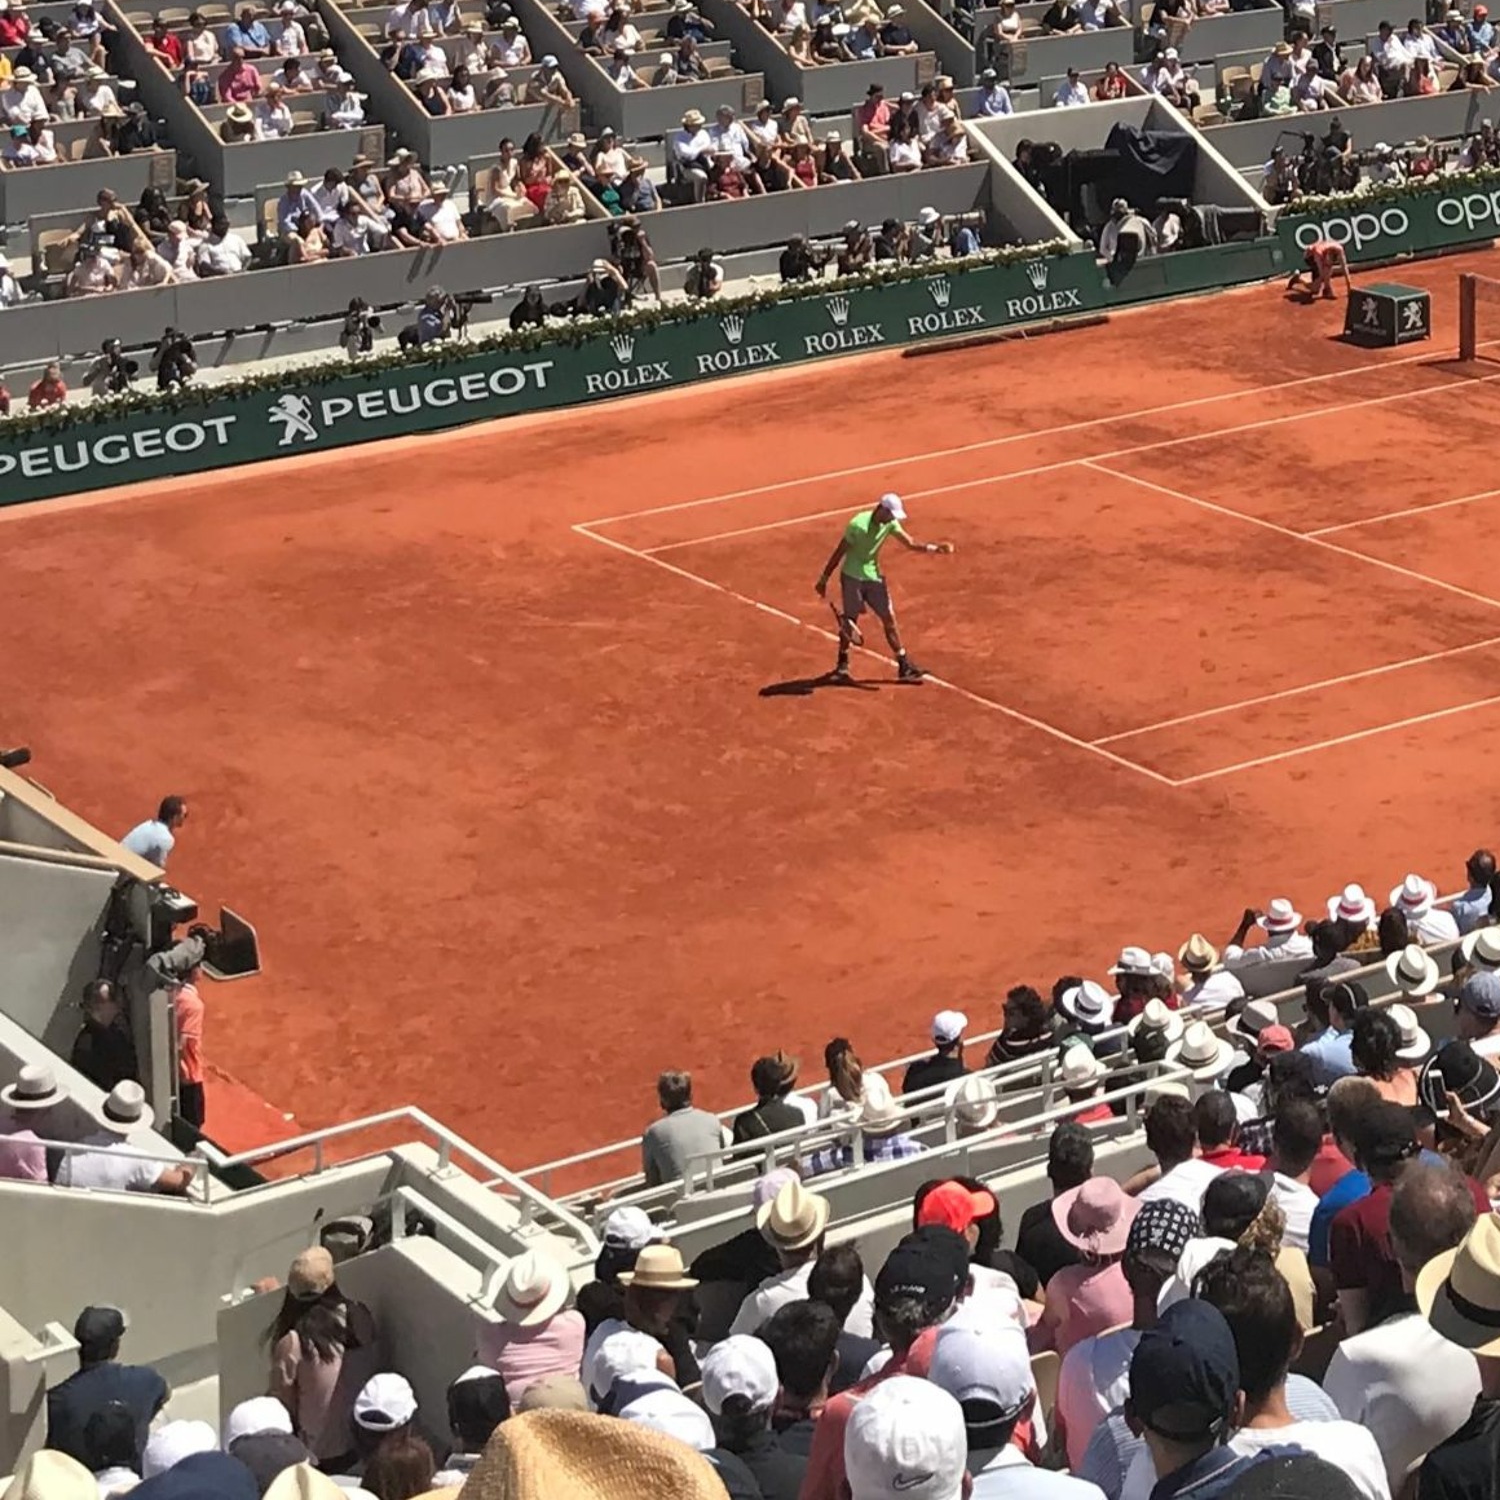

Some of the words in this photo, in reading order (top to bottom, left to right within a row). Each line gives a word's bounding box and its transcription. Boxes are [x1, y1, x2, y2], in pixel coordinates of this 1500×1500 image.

[587, 362, 673, 393] ROLEX
[697, 342, 781, 374] ROLEX
[805, 324, 885, 354] ROLEX
[909, 306, 986, 335] ROLEX
[1007, 289, 1082, 317] ROLEX
[321, 360, 554, 426] PEUGEOT
